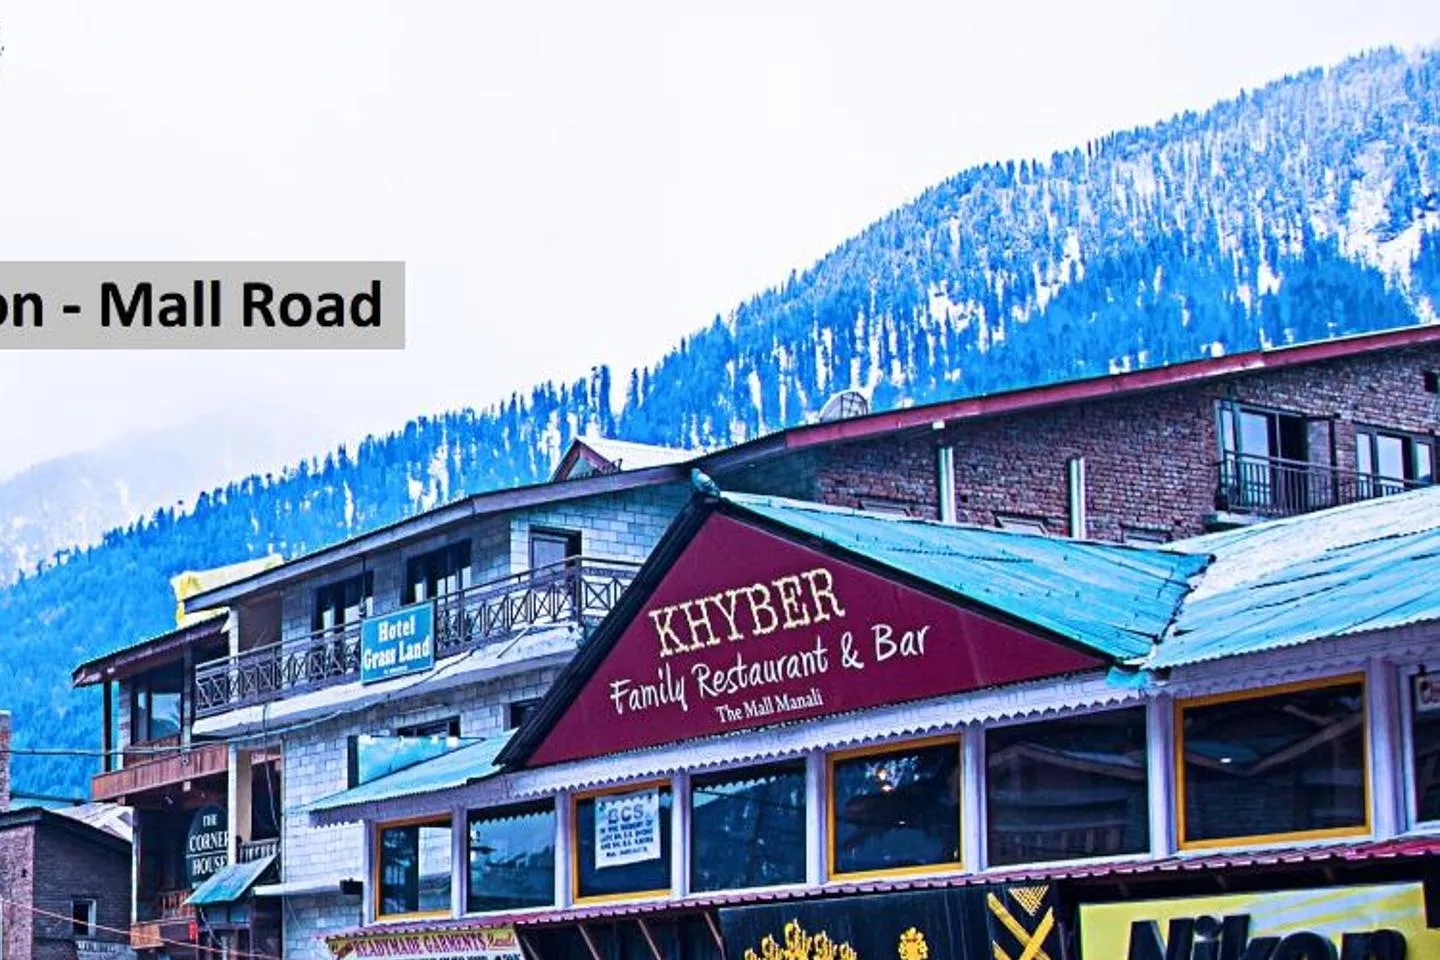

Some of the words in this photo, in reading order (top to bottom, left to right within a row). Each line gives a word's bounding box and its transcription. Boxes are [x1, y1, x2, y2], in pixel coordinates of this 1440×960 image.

[378, 614, 416, 643] Hotel
[648, 568, 846, 659] KHYBER
[364, 647, 397, 672] Grass
[398, 634, 431, 663] Land
[610, 662, 689, 715] Family
[692, 636, 829, 699] Restaurant
[840, 631, 865, 669] &
[872, 623, 931, 663] Bar
[715, 704, 743, 724] The
[744, 696, 774, 718] Mall
[776, 687, 824, 713] Manali
[202, 813, 218, 827] THE
[423, 932, 490, 954] GARMENTS
